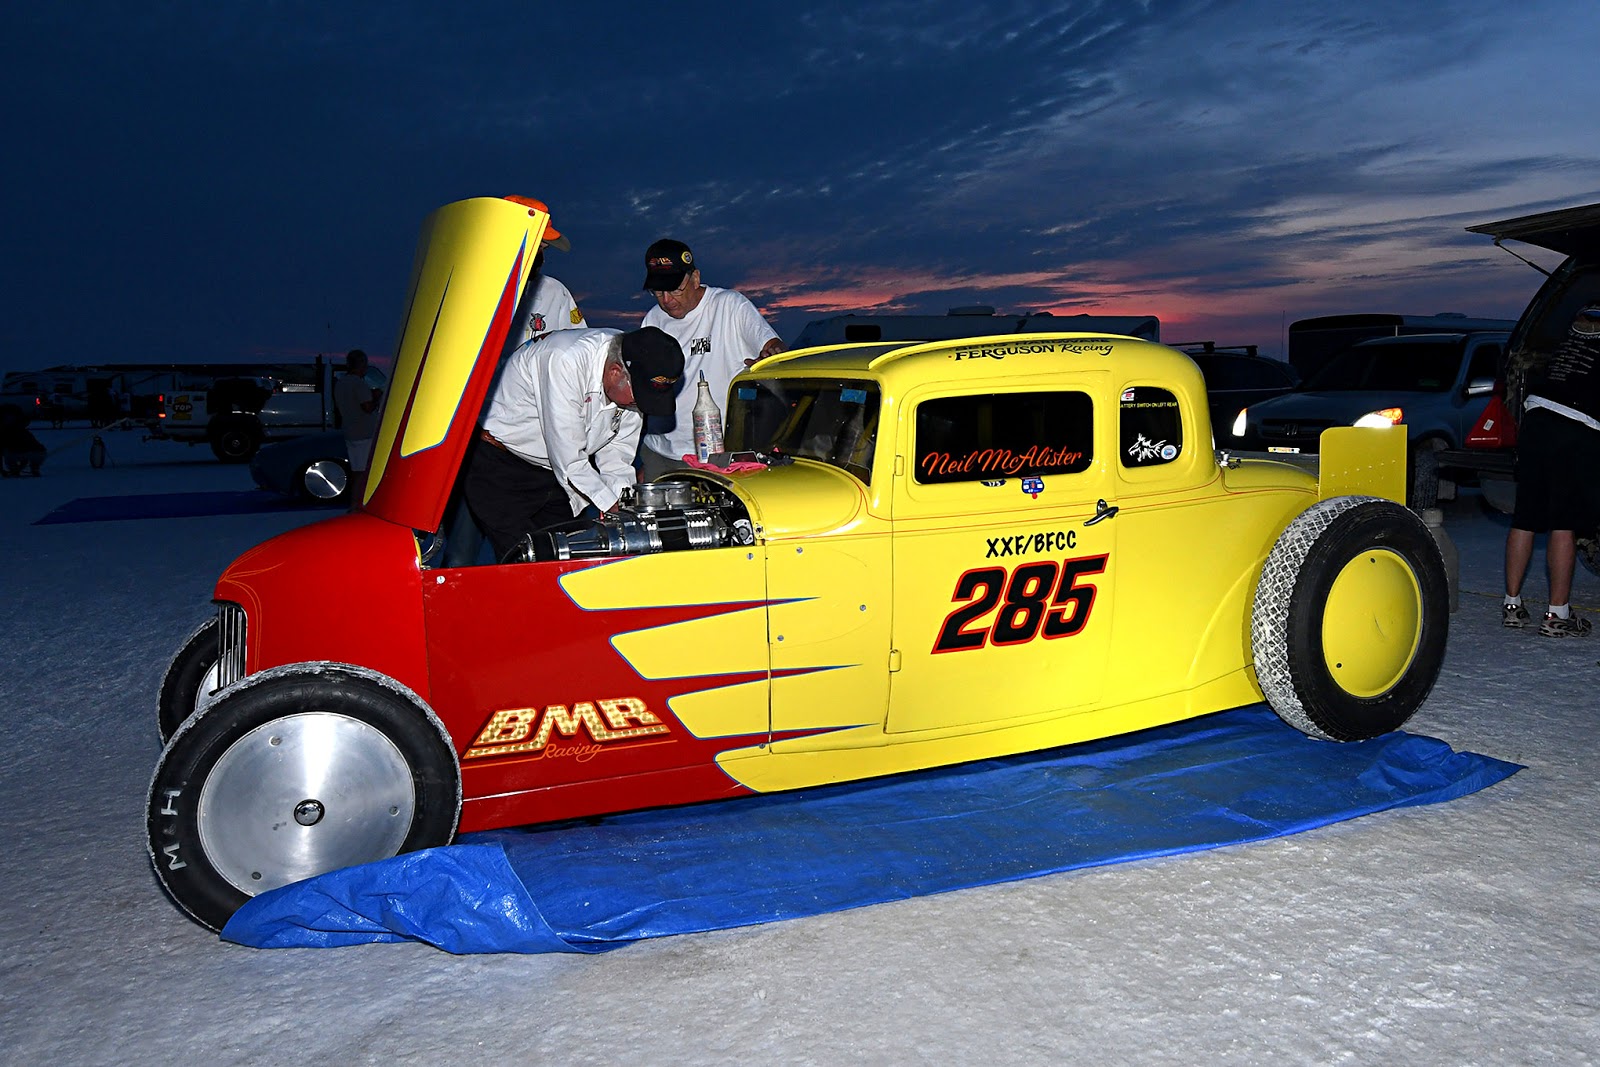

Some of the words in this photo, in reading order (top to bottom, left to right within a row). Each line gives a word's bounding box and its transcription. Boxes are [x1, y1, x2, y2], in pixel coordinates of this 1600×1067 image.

[955, 344, 1054, 361] FERGUSON
[1058, 343, 1114, 356] Racing
[921, 450, 979, 476] Neil
[978, 445, 1083, 475] McAlister
[985, 530, 1077, 558] XXF/BFCC
[930, 552, 1110, 655] 285
[462, 696, 672, 760] BMR
[542, 743, 603, 763] Racing
